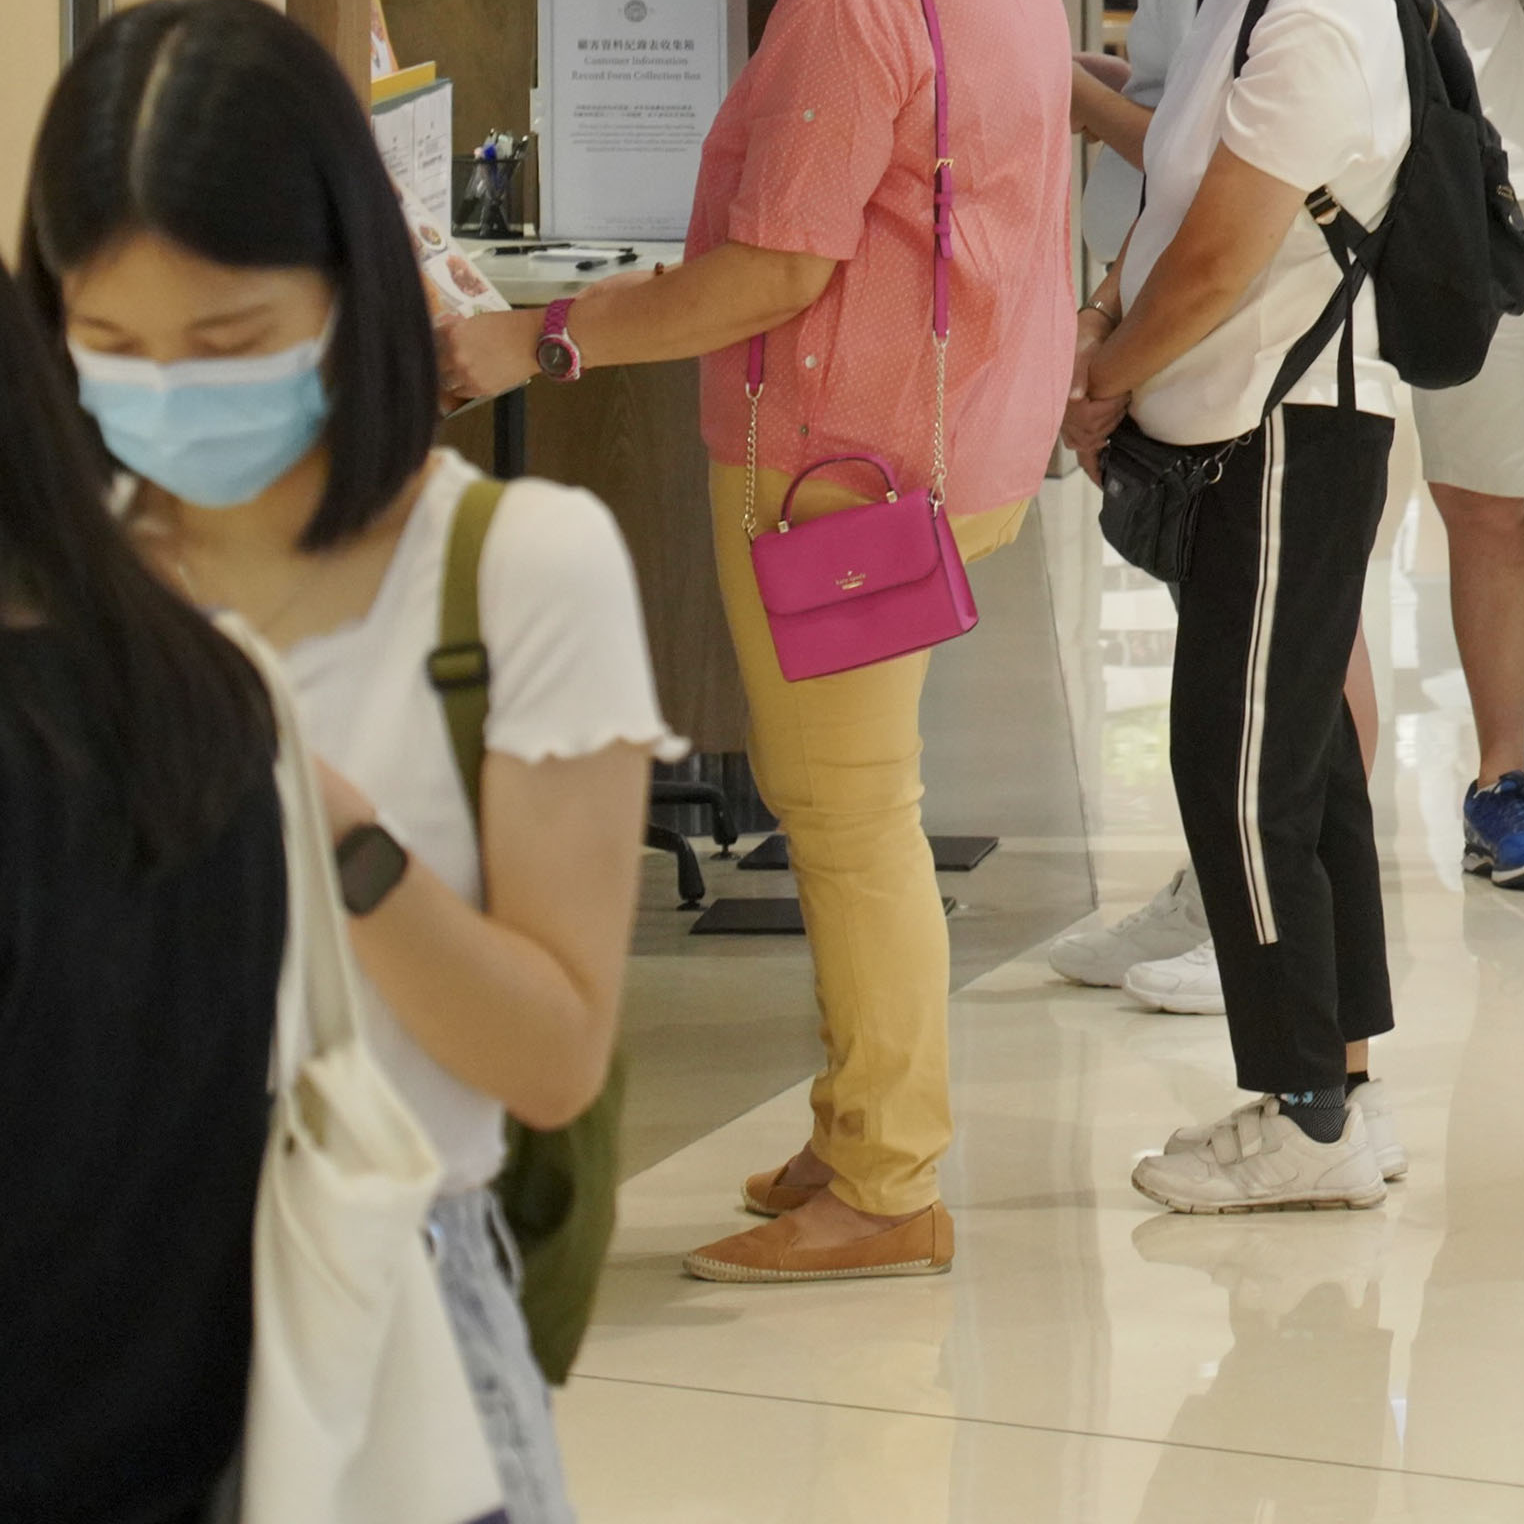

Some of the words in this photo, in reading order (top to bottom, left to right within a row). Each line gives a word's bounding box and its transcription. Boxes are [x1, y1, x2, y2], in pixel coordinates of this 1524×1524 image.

[584, 56, 629, 66] Customer
[632, 56, 689, 66] Information
[571, 71, 604, 81] Record
[607, 71, 632, 81] Form
[633, 71, 682, 81] Collection
[684, 71, 701, 81] Box
